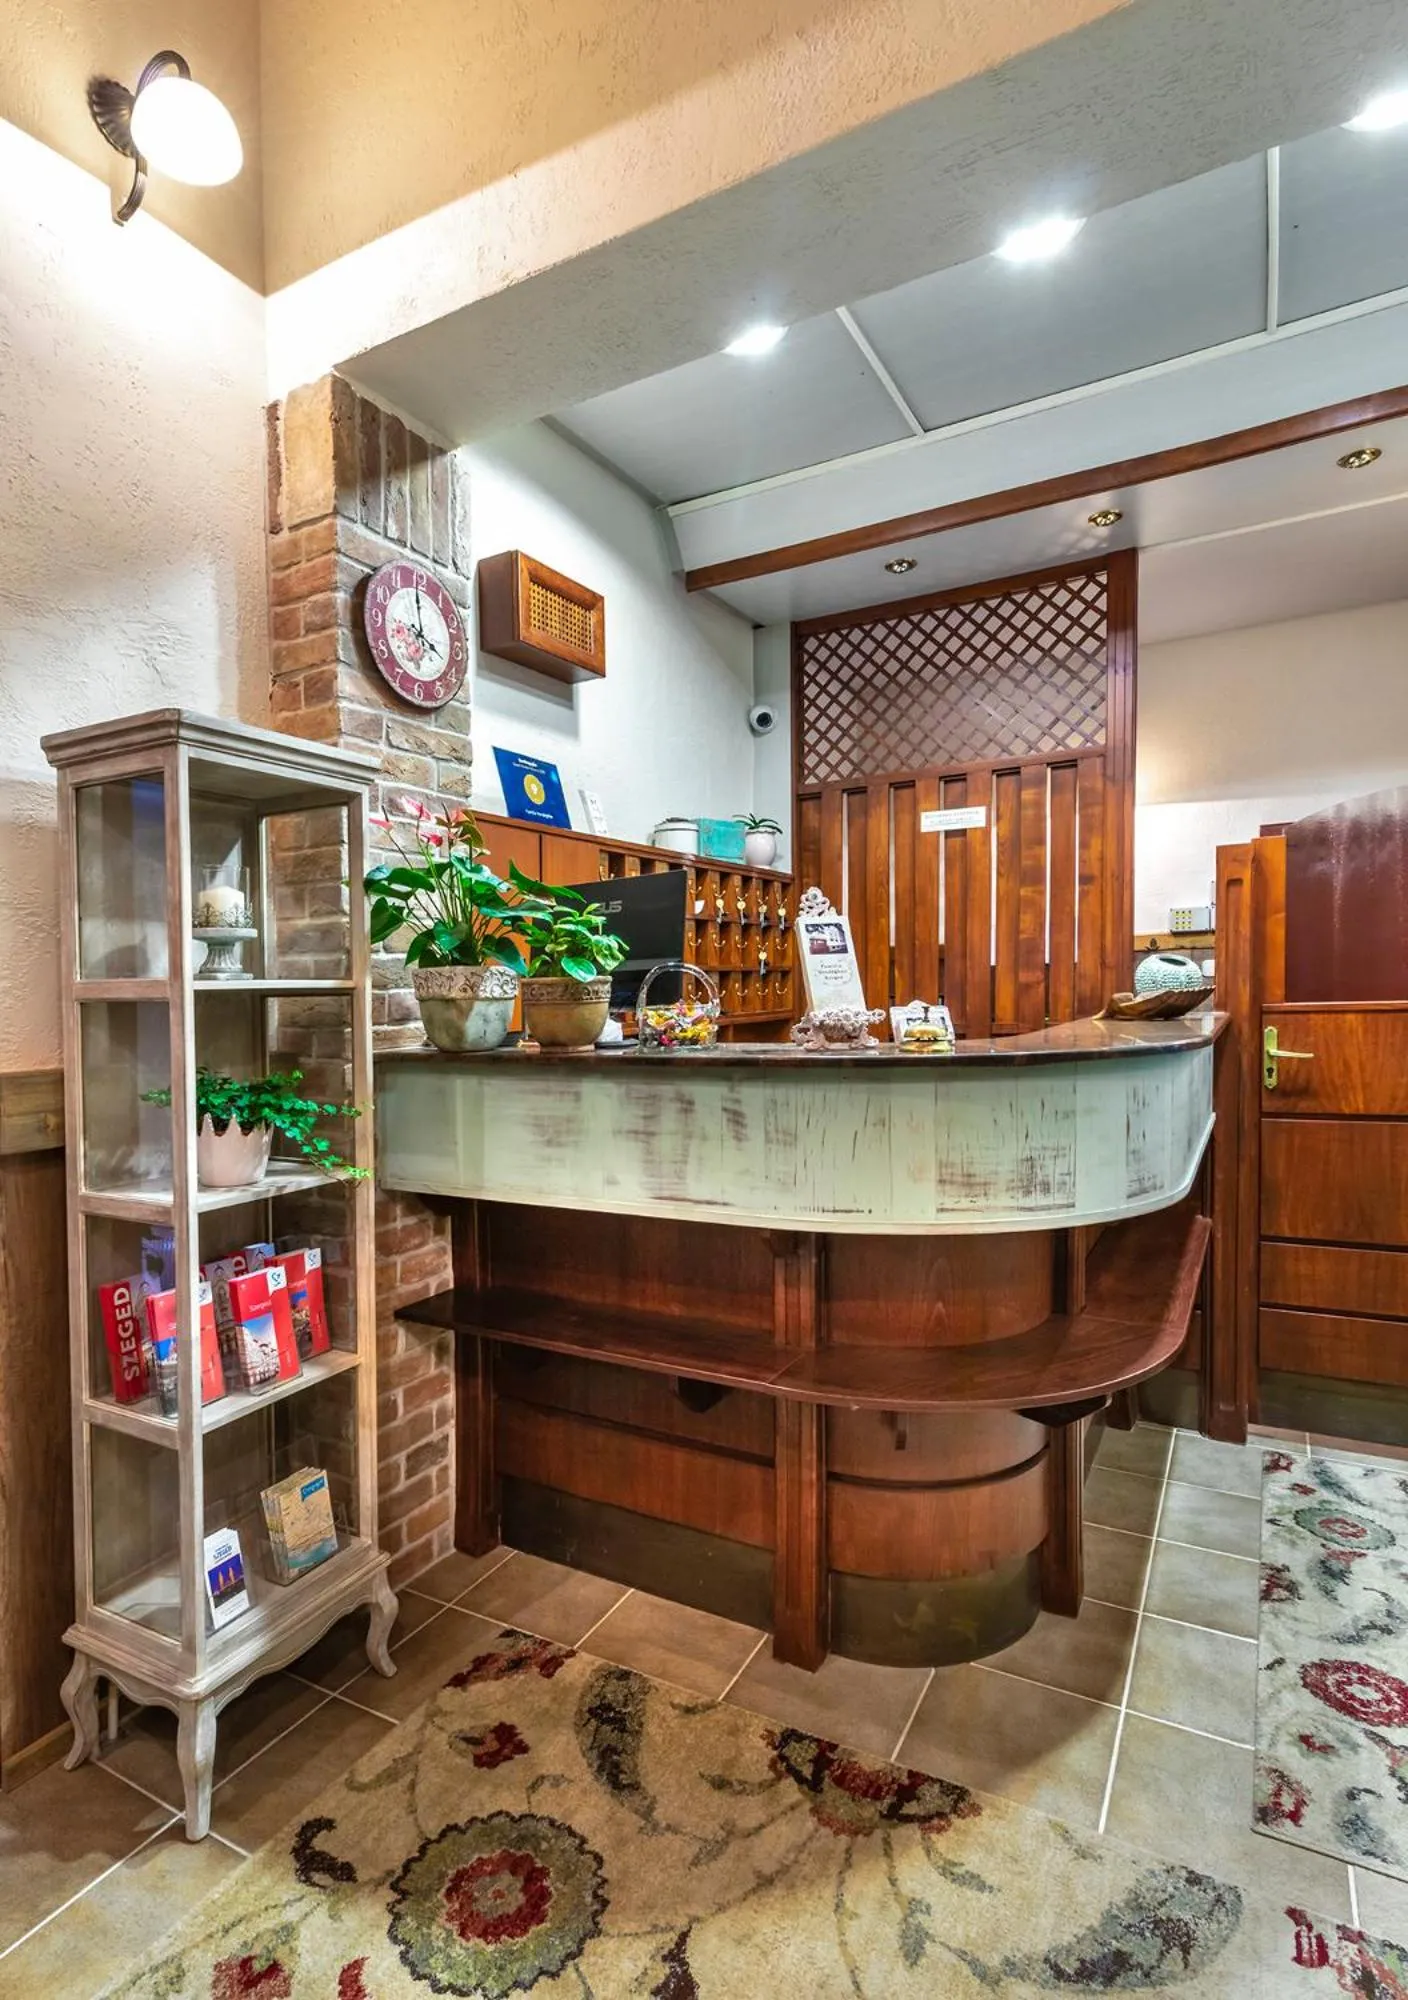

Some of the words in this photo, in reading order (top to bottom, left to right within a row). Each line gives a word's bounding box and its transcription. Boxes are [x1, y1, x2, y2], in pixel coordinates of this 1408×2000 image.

[391, 568, 401, 589] 11
[413, 569, 427, 591] 12
[376, 585, 391, 606] 10
[372, 607, 383, 628] 9
[447, 613, 458, 634] 2
[377, 639, 389, 659] 8
[451, 641, 463, 661] 3
[394, 667, 404, 687] 7
[446, 667, 458, 684] 4
[414, 682, 424, 701] 6
[434, 680, 444, 699] 5
[113, 1287, 140, 1382] SZEGED
